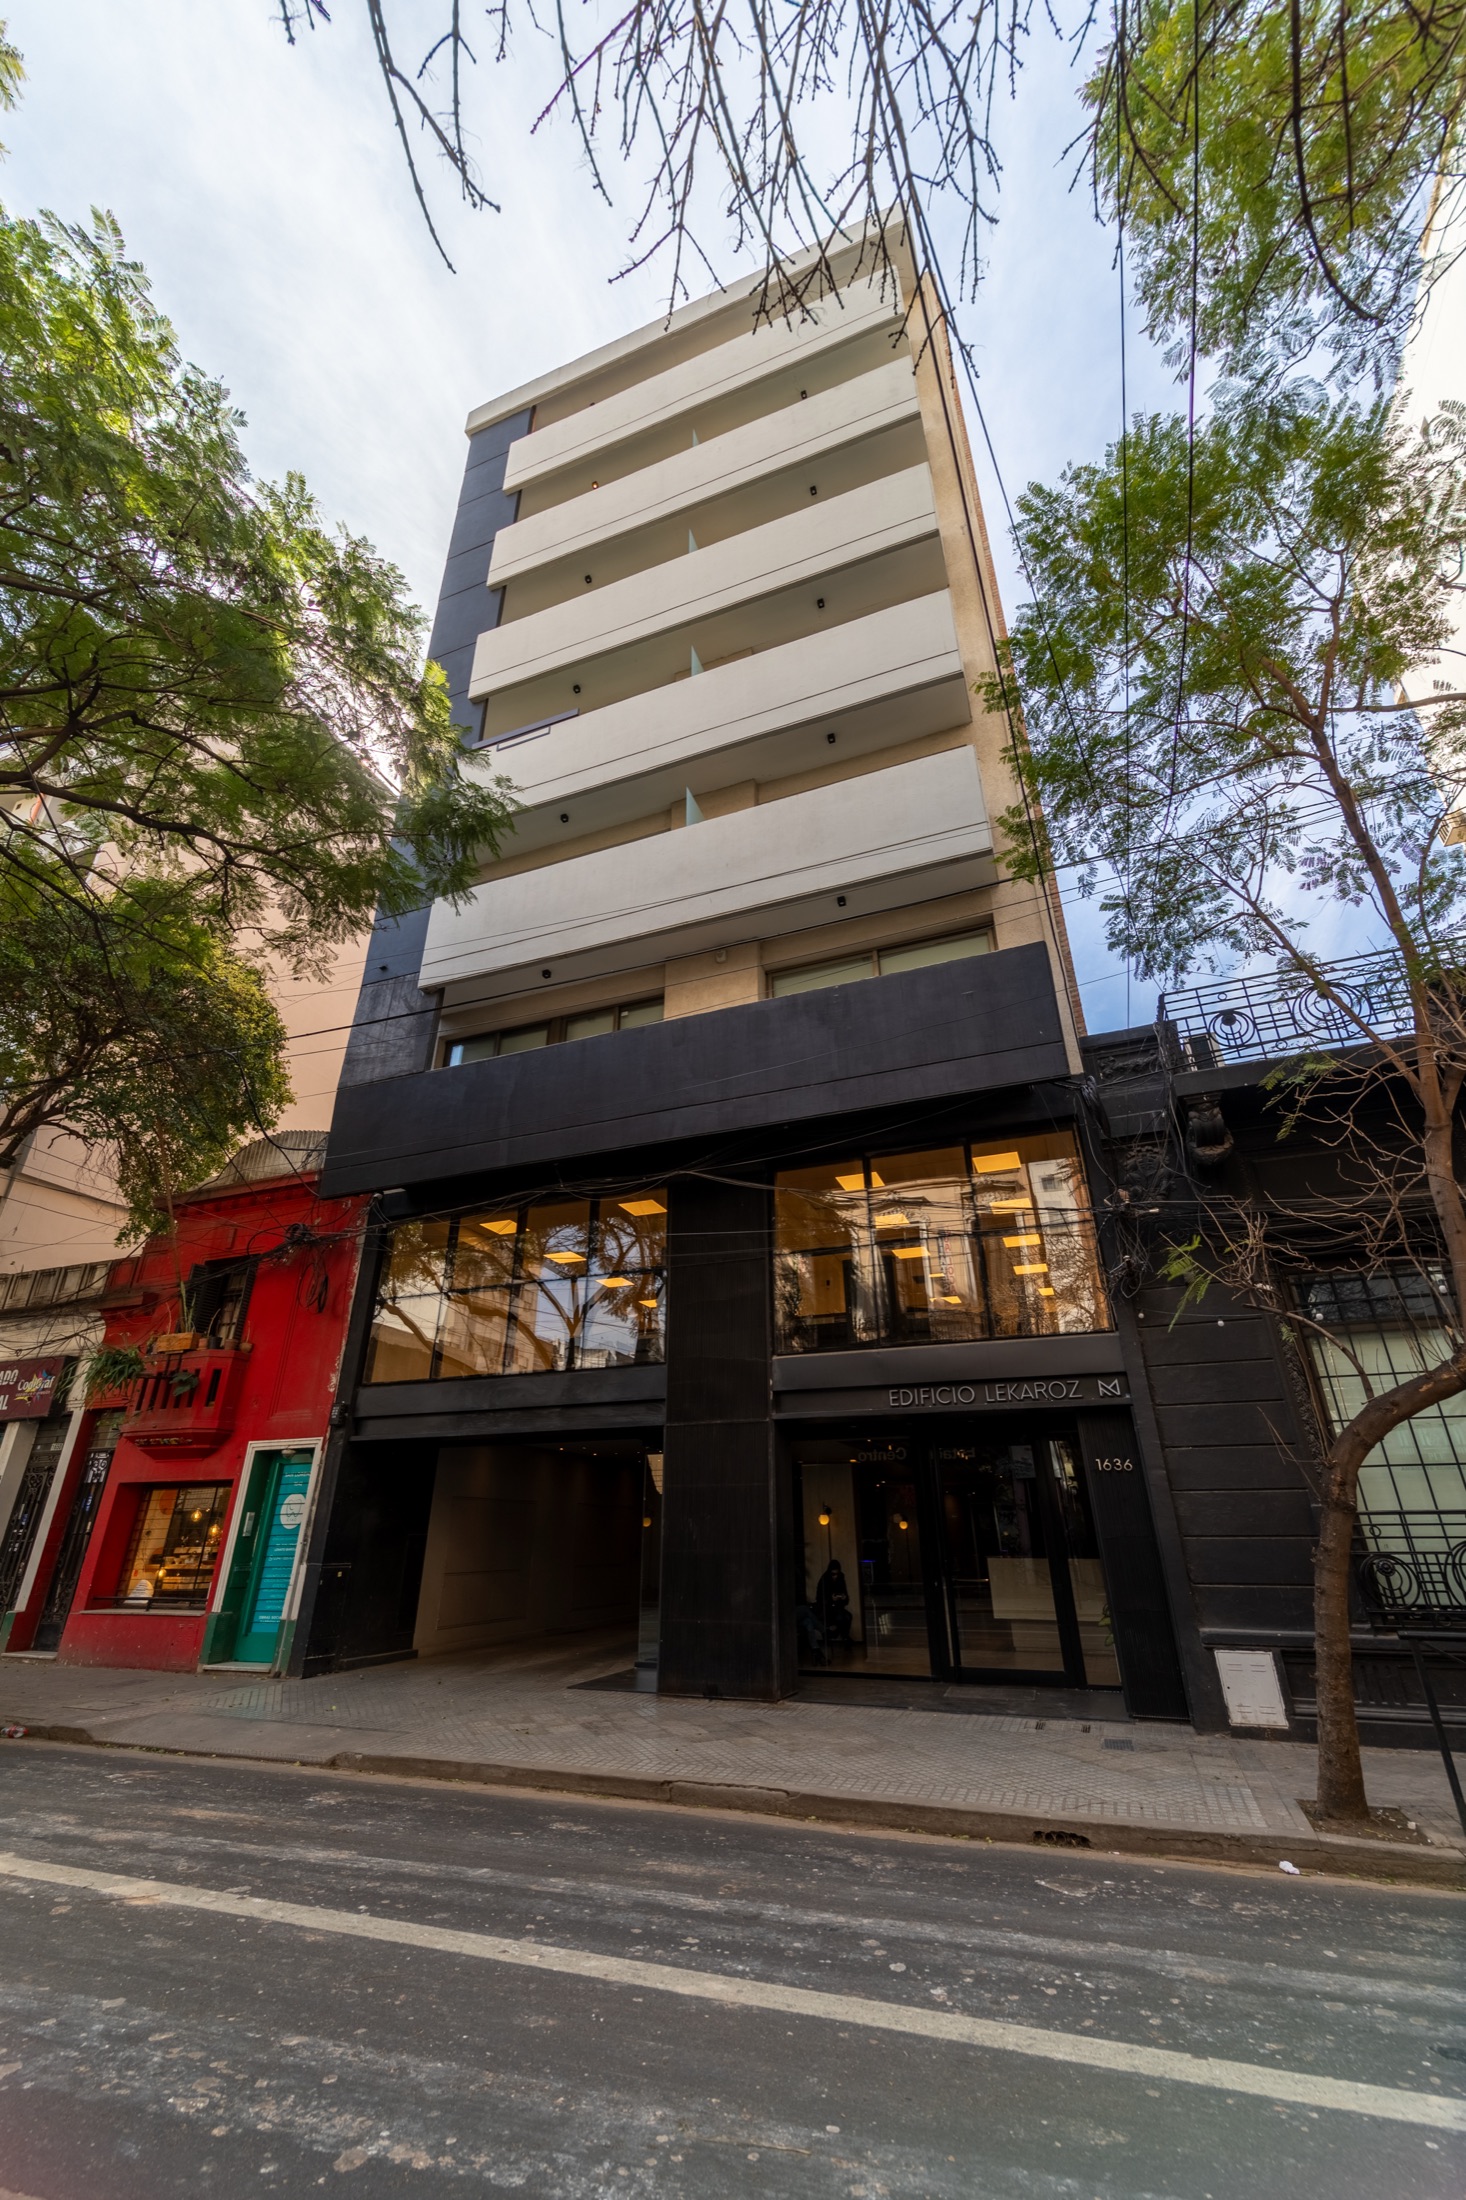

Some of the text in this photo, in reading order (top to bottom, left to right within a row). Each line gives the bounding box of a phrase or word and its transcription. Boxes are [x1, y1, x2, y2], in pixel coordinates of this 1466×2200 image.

[889, 1385, 976, 1407] EDIFICIO
[985, 1380, 1083, 1403] LEKAROZ
[1095, 1458, 1133, 1471] 1636
